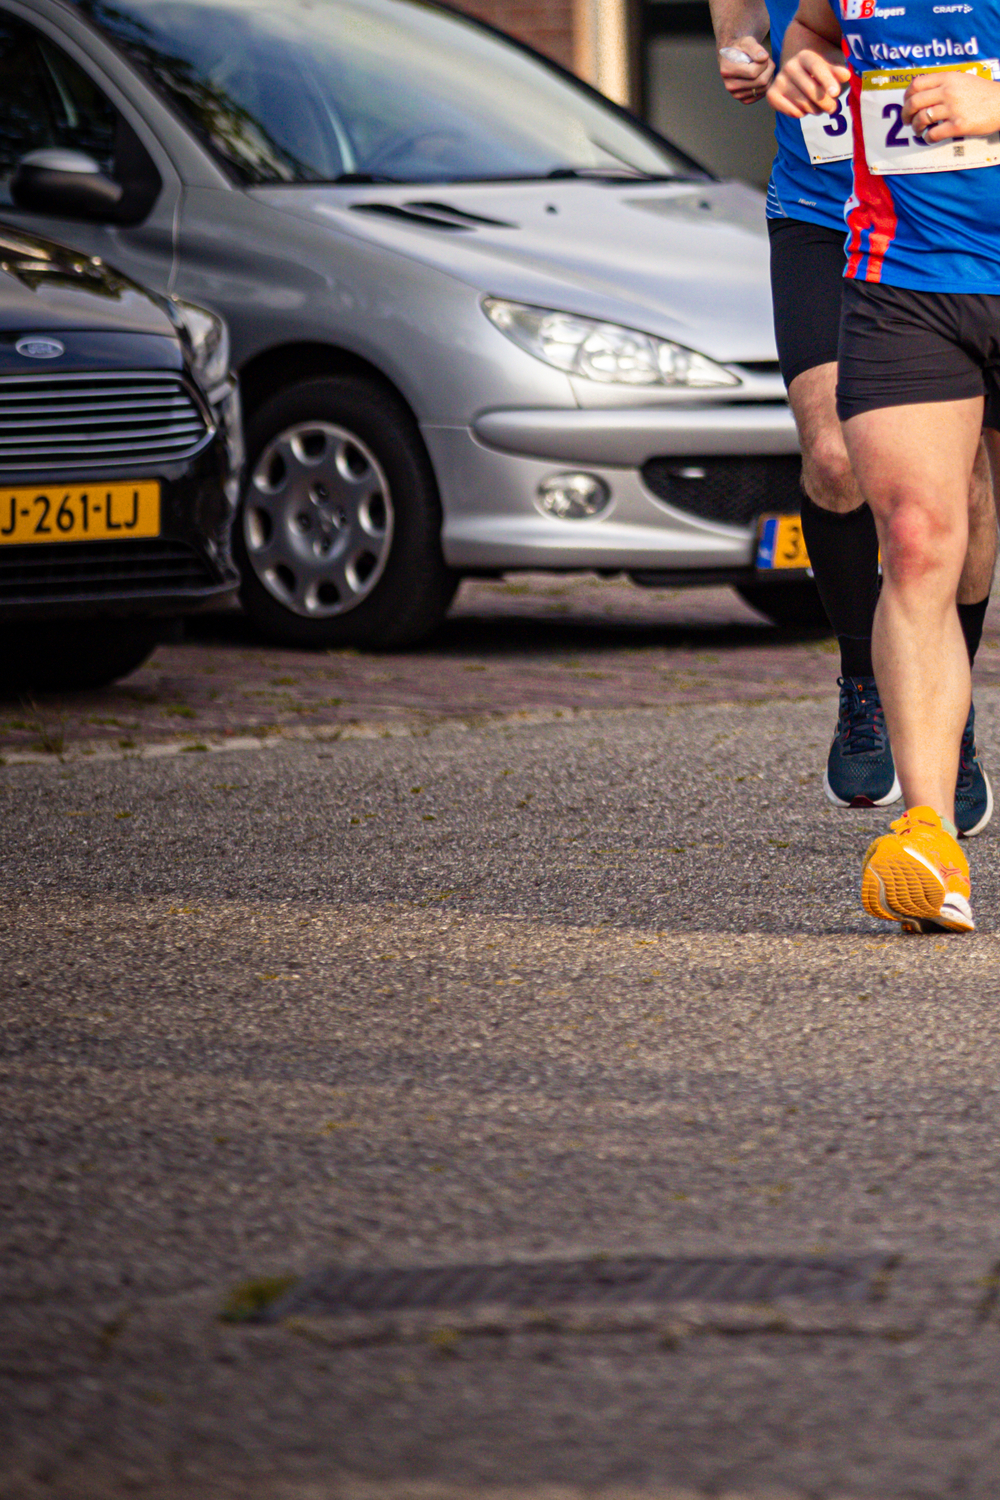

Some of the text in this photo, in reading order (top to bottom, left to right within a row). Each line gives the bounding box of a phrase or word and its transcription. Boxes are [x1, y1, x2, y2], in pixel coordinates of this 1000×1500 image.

[932, 5, 963, 14] CRAFT
[869, 36, 979, 60] Klaverblad
[1, 491, 139, 535] J-261-LJ
